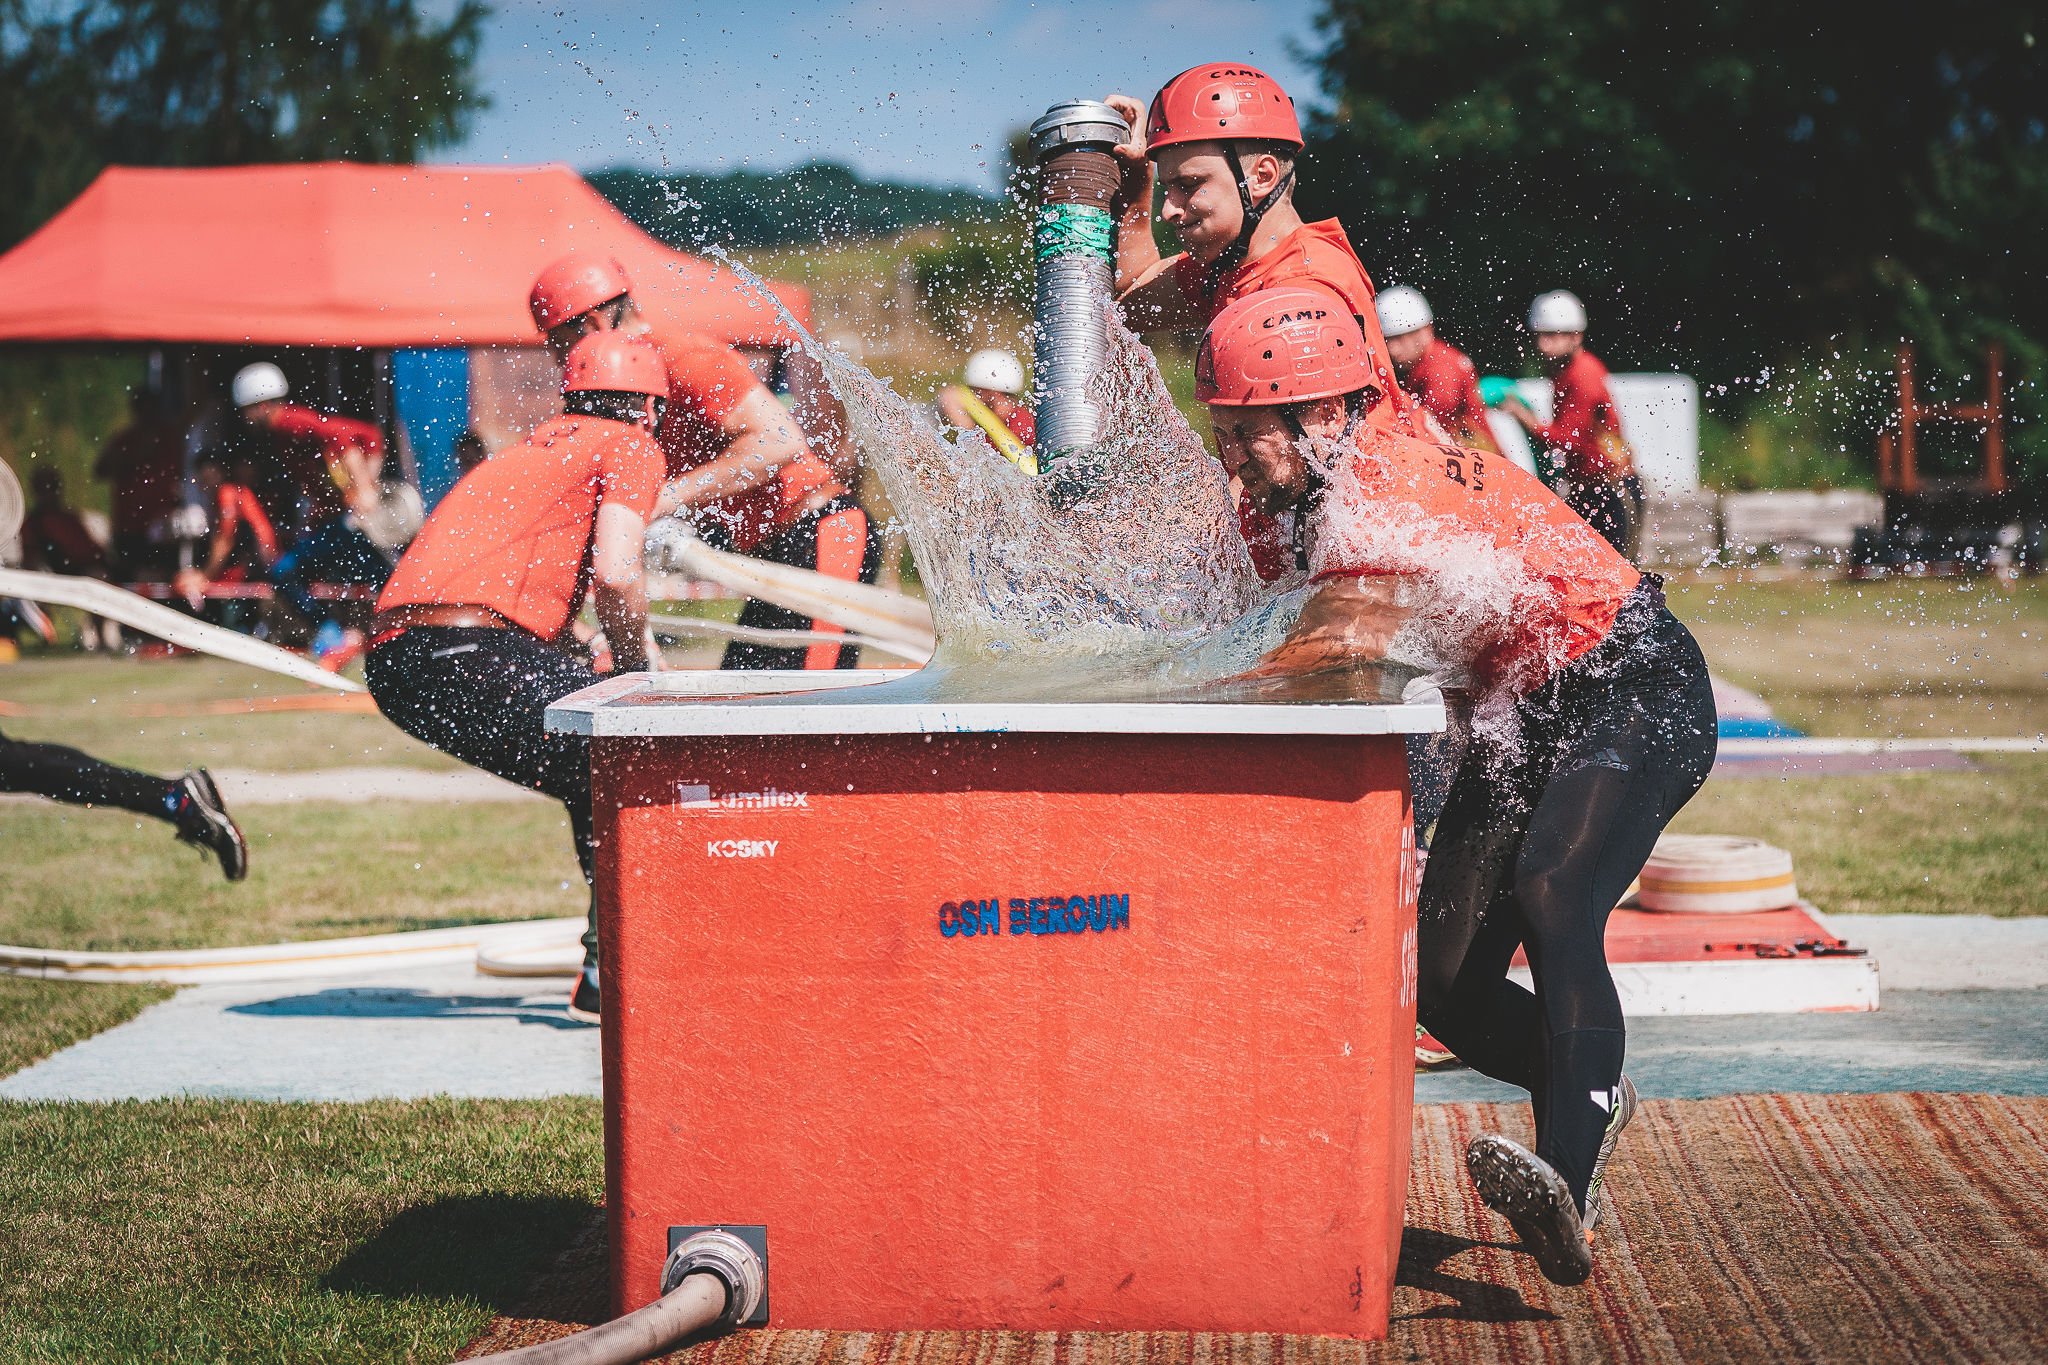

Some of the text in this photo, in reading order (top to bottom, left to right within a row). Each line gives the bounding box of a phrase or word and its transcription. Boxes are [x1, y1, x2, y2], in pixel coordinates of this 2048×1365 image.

[1210, 69, 1265, 79] CAMP
[1262, 310, 1327, 329] CAMP
[1579, 758, 1630, 772] didas
[707, 840, 779, 858] KOSKY
[1009, 894, 1130, 936] BEROUN
